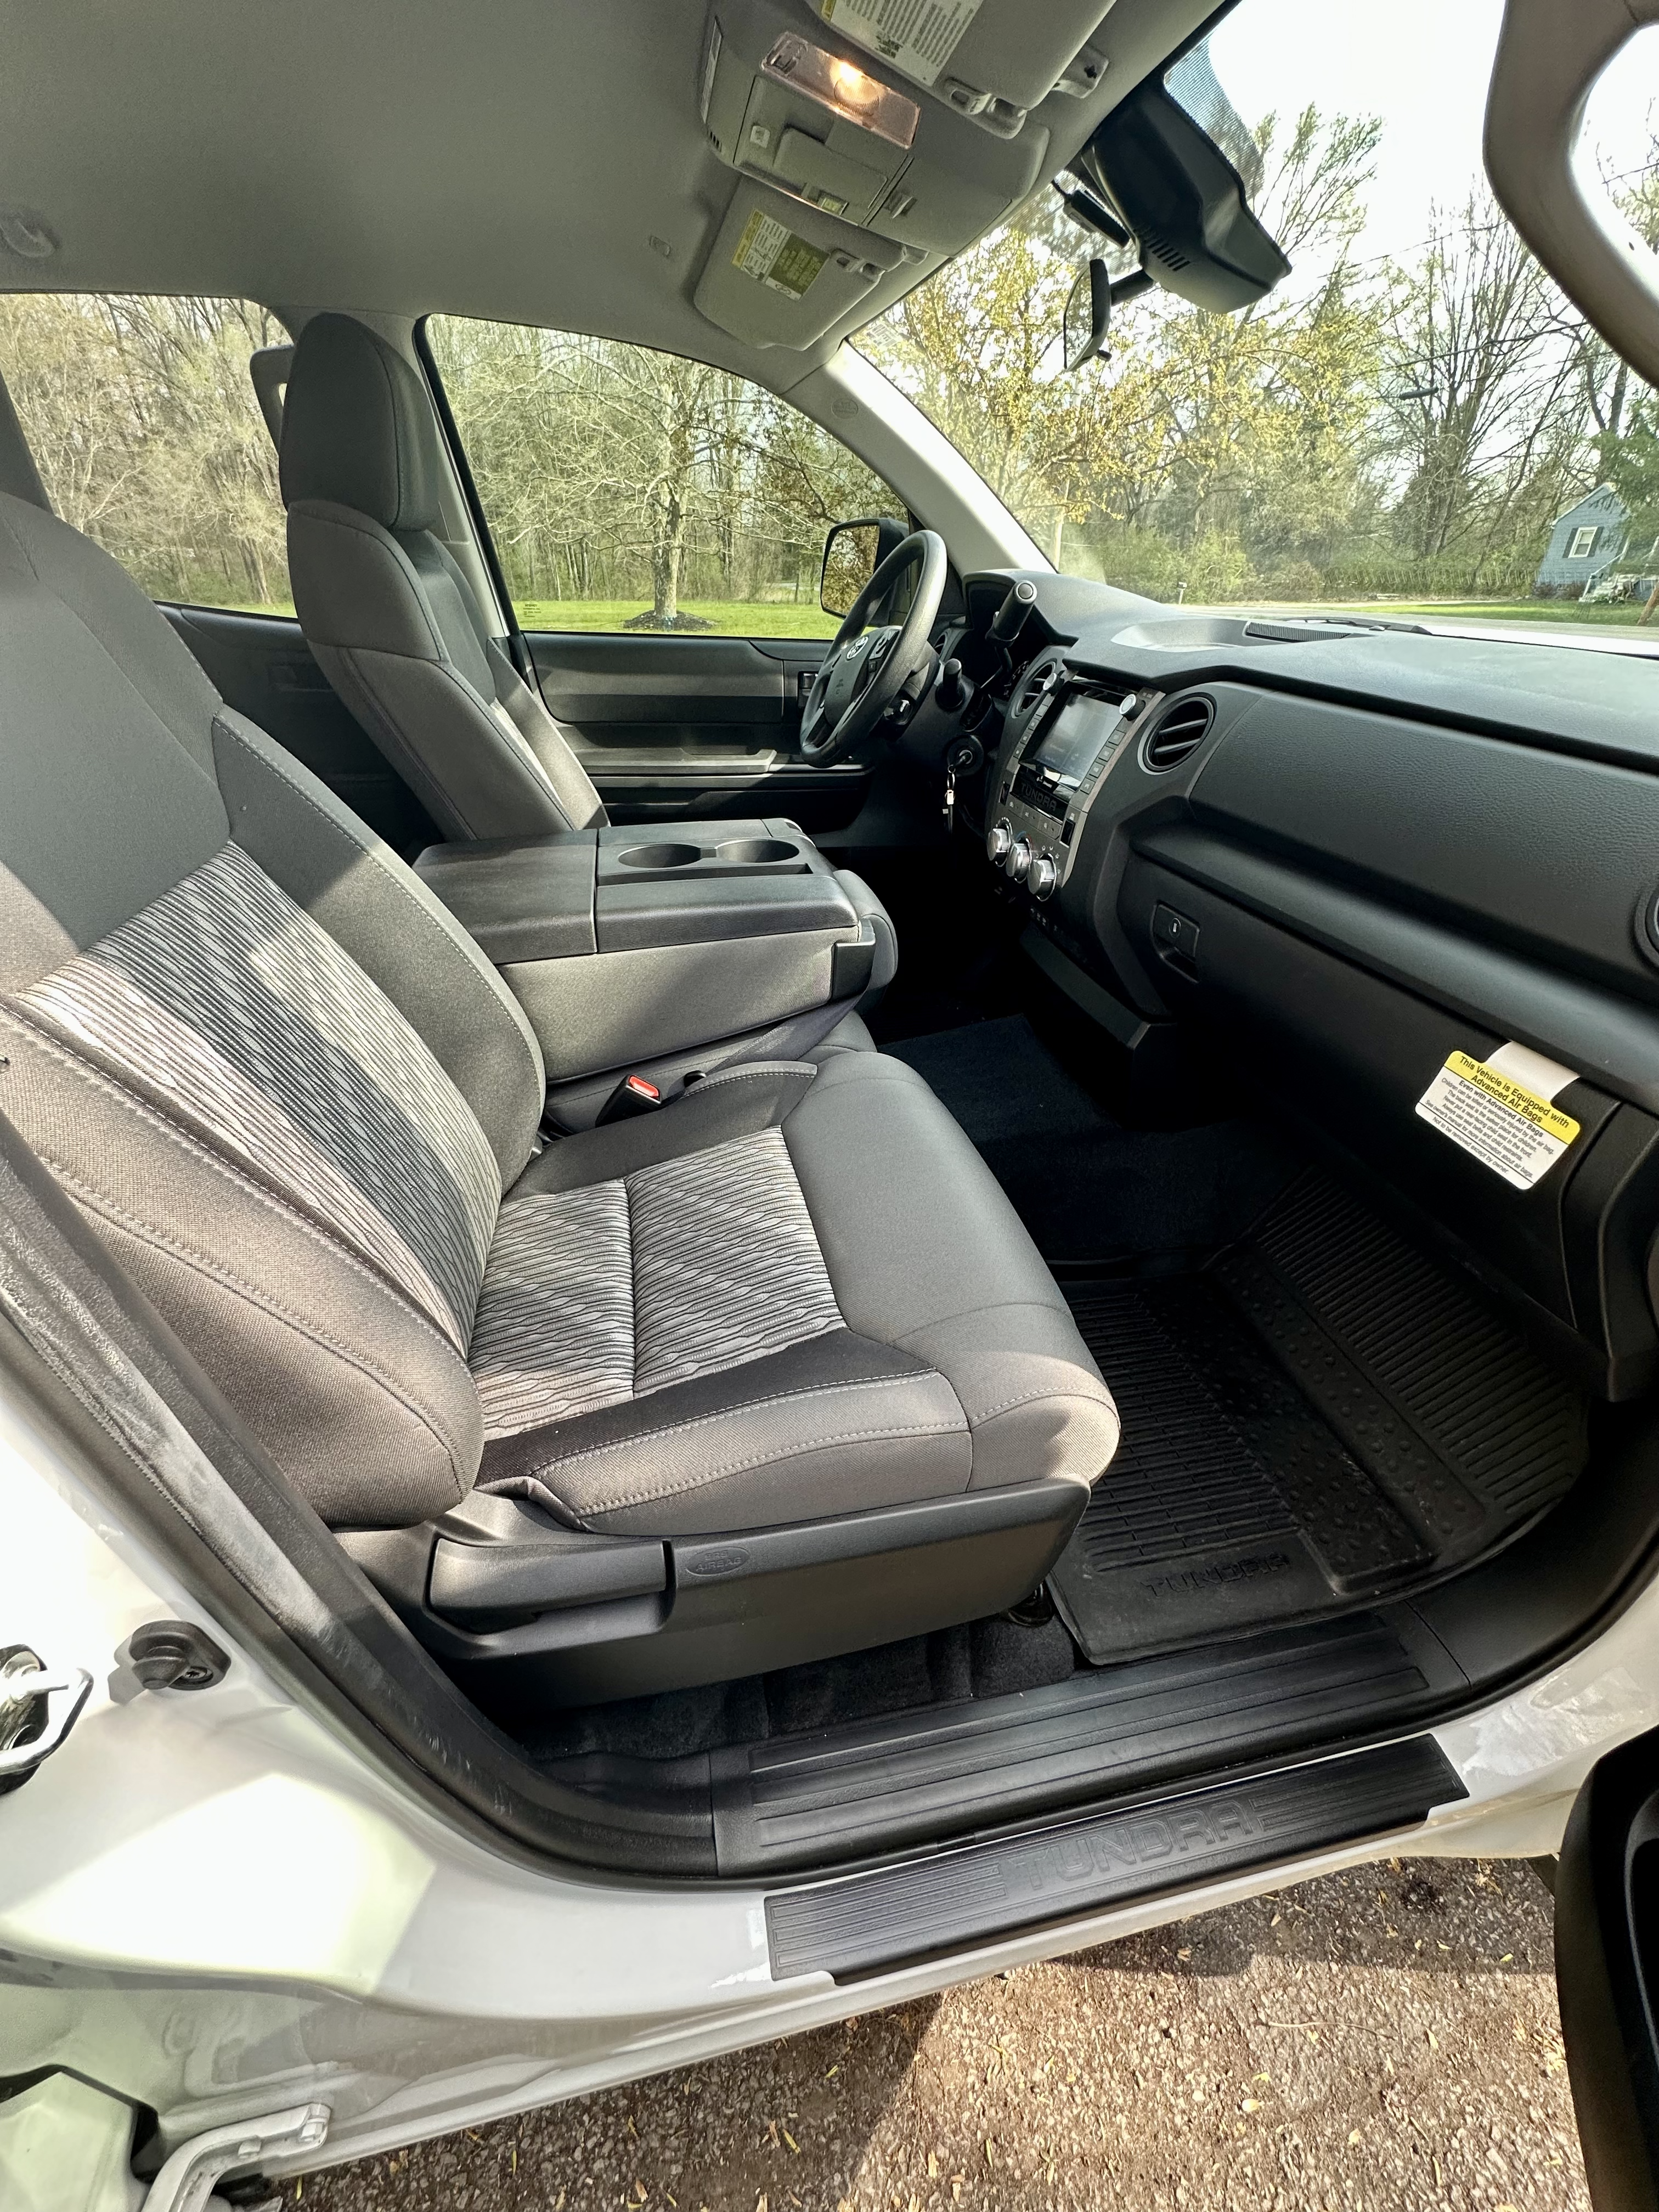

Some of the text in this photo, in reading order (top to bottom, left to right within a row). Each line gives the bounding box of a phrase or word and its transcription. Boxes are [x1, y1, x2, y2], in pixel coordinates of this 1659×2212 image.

[1021, 782, 1057, 811] TUNDRA
[1441, 1077, 1458, 1091] Children
[1471, 1097, 1483, 1107] killed
[1487, 1108, 1508, 1124] seriously
[1506, 1120, 1523, 1133] injured
[1528, 1134, 1537, 1142] the
[1447, 1089, 1455, 1098] The
[1455, 1094, 1466, 1104] back
[1465, 1102, 1475, 1110] seat
[1497, 1125, 1511, 1135] place
[1458, 1080, 1543, 1137] Even with Advanced Air Bags
[1459, 1056, 1569, 1128] This Vehicle is Equipped with
[1470, 1075, 1543, 1122] Advanced Air Bags
[1425, 1099, 1434, 1108] See
[1447, 1115, 1463, 1127] manual
[1467, 1130, 1479, 1139] more
[1477, 1136, 1502, 1155] information
[1500, 1154, 1515, 1165] about
[1432, 1116, 1441, 1125] Not
[1451, 1131, 1472, 1147] removed
[1470, 1145, 1487, 1158] except
[1441, 1103, 1456, 1115] Always
[1463, 1118, 1474, 1126] seat
[1482, 1131, 1493, 1139] and
[1491, 1137, 1503, 1147] child
[1442, 1094, 1456, 1105] Never
[1486, 1125, 1498, 1135] child
[1497, 1132, 1508, 1141] seat
[1511, 1142, 1520, 1150] the
[696, 1556, 741, 1572] AIRBAG
[1141, 1552, 1291, 1597] TUNDRA
[1007, 1801, 1254, 1890] TUNDRA
